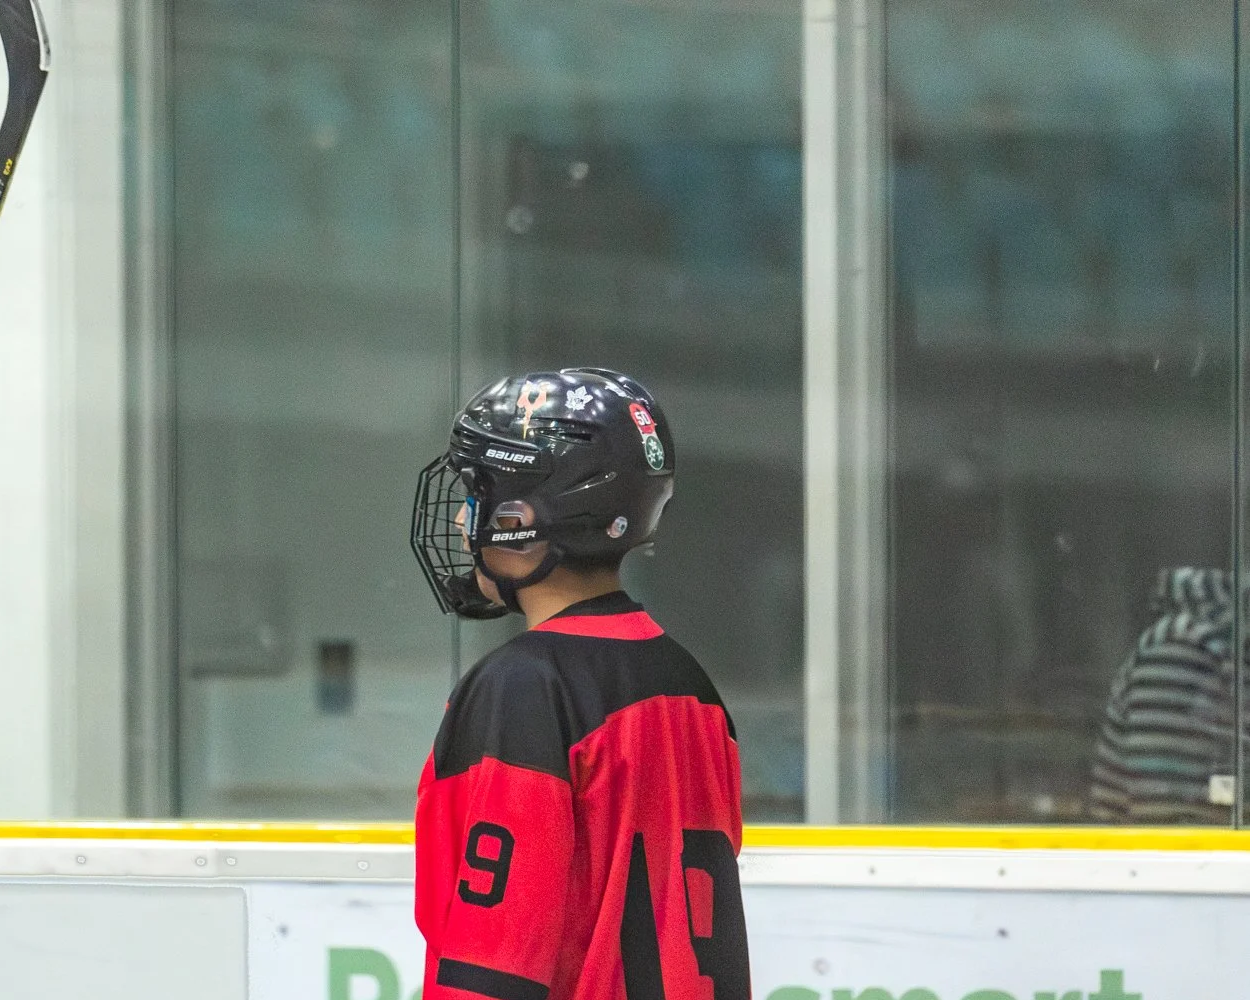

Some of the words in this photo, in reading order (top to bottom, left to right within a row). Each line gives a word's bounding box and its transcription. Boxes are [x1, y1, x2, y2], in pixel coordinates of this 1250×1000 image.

[485, 448, 536, 465] BAUER
[491, 529, 537, 542] BAUER
[457, 822, 515, 908] 9
